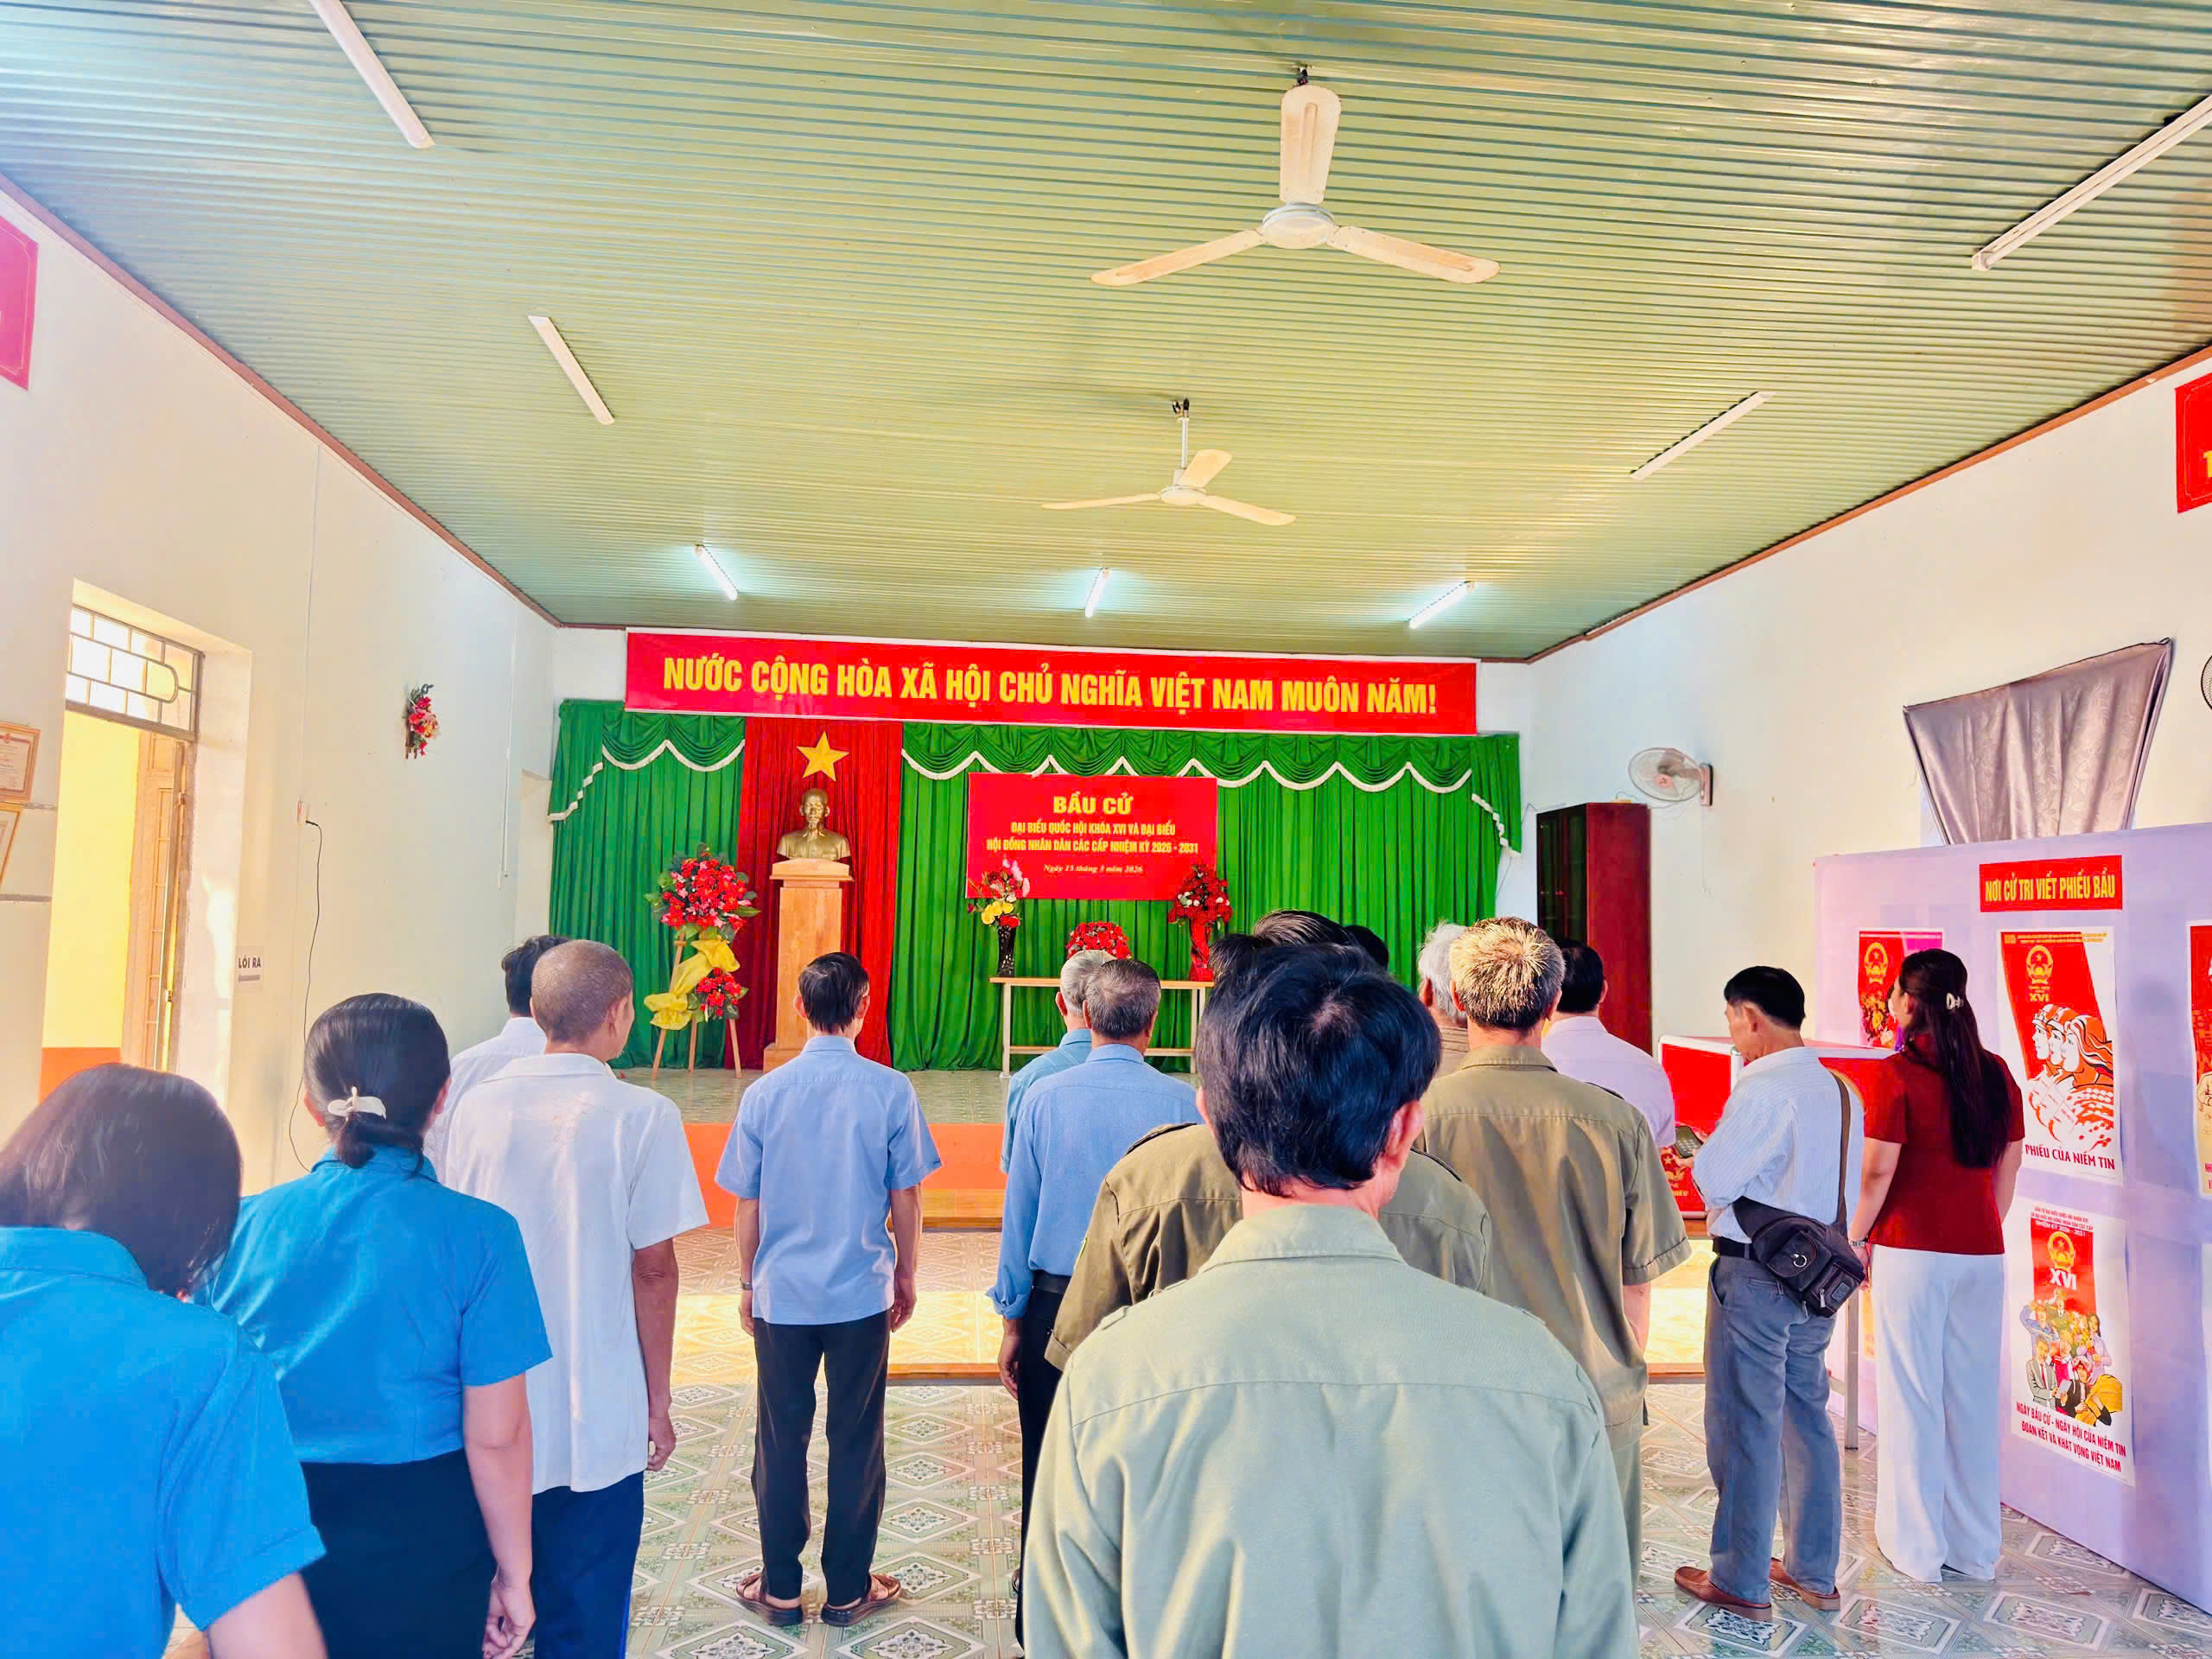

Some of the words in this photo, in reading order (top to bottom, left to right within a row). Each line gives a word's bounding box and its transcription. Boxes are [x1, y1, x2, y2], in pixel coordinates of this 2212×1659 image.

[664, 652, 742, 691] NƯỚC
[751, 655, 829, 701] CỘNG
[836, 658, 892, 698] HÒA
[900, 661, 938, 699] XÃ
[945, 664, 990, 708] HỘI
[999, 663, 1052, 704] CHỦ
[1060, 670, 1142, 706] NGHĨA
[1150, 671, 1205, 715] VIỆT
[1212, 678, 1273, 712] NAM
[1281, 676, 1358, 714] MUÔN
[1367, 677, 1438, 715] NĂM!
[1052, 791, 1096, 815] BẦU
[1103, 792, 1134, 815] CỬ
[1011, 822, 1026, 836] ĐẠI
[1027, 818, 1047, 834] BIỂU
[1049, 819, 1071, 834] QUỐC
[1073, 821, 1087, 836] HỘI
[1113, 823, 1127, 835] XVI
[1128, 822, 1140, 835] VÀ
[1141, 823, 1155, 836] ĐẠI
[1156, 820, 1176, 836] BIỂU
[987, 836, 1001, 853] HỘI
[1003, 836, 1027, 851] ĐỒNG
[1027, 837, 1052, 851] NHÂN
[1053, 837, 1071, 851] DÂN
[1072, 837, 1090, 852] CÁC
[1091, 837, 1109, 852] CẤP
[1110, 839, 1137, 855] NHIỆM
[1139, 839, 1150, 852] KỲ
[1044, 864, 1063, 874] Ngày
[1076, 864, 1098, 874] tháng
[1985, 878, 2002, 902] NƠI
[2003, 872, 2018, 901] CỬ
[2018, 879, 2034, 900] TRI
[2036, 871, 2057, 899] VIẾT
[2059, 868, 2091, 899] PHIẾU
[2093, 867, 2116, 899] BẦU
[238, 955, 251, 969] LỐI
[251, 957, 261, 969] RA
[2028, 993, 2050, 1002] XVI
[2024, 1143, 2050, 1159] PHIẾU
[2052, 1147, 2071, 1162] CỦA
[2098, 1156, 2115, 1170] TIN
[2050, 1268, 2077, 1290] XVI
[2016, 1401, 2031, 1416] NGÀY
[2031, 1407, 2043, 1422] BẦU
[2043, 1412, 2051, 1426] CỬ
[2056, 1418, 2071, 1434] NGÀY
[2072, 1424, 2082, 1440] HỘI
[2083, 1428, 2096, 1445] CỦA
[2115, 1443, 2126, 1458] TIN
[2038, 1427, 2048, 1441] KẾT
[2073, 1443, 2089, 1459] VỌNG
[2090, 1451, 2104, 1466] VIỆT
[2105, 1457, 2122, 1472] NAM
